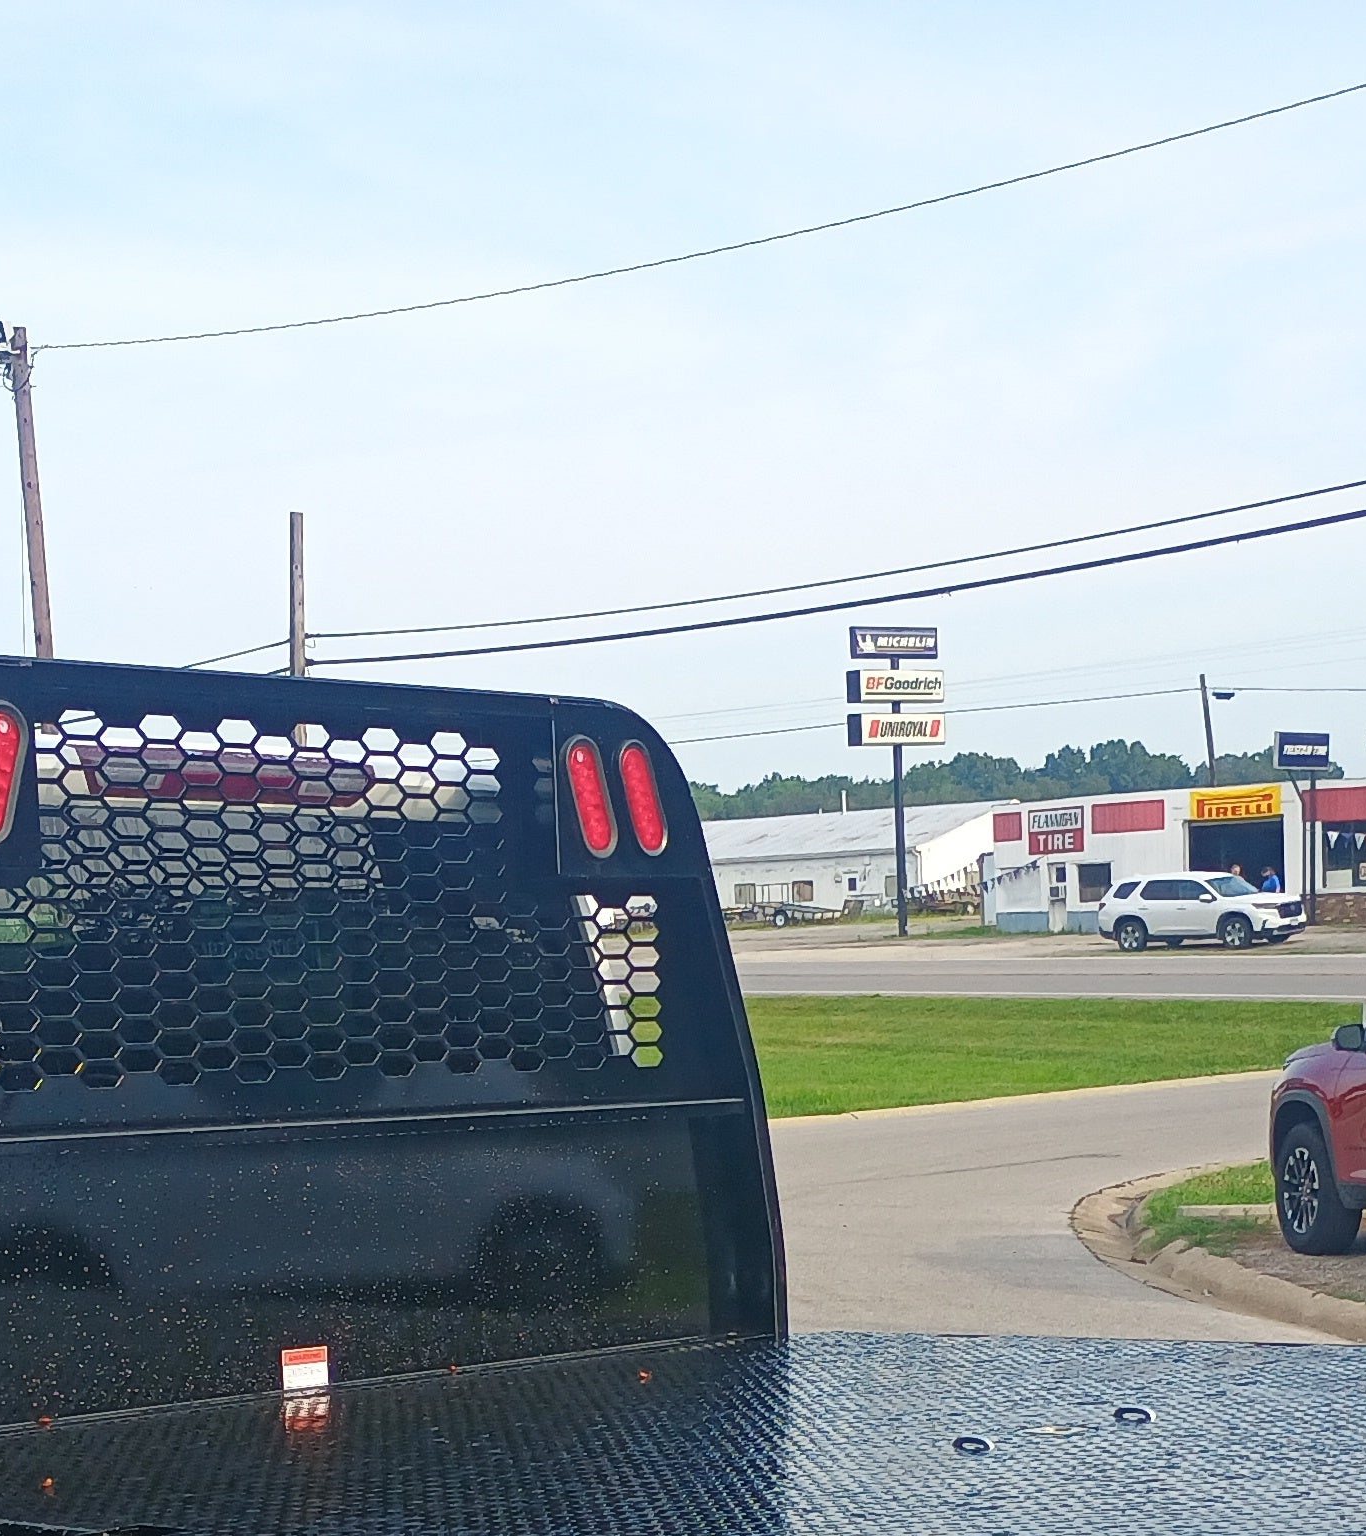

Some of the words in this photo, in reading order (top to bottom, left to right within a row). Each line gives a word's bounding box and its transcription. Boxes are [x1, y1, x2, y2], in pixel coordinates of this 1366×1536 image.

[877, 636, 935, 648] MICHELIN
[866, 676, 941, 690] BFGoodrich
[880, 720, 928, 738] UNIROYAL
[1196, 793, 1274, 819] PIRELLI
[1037, 832, 1074, 851] TIRE
